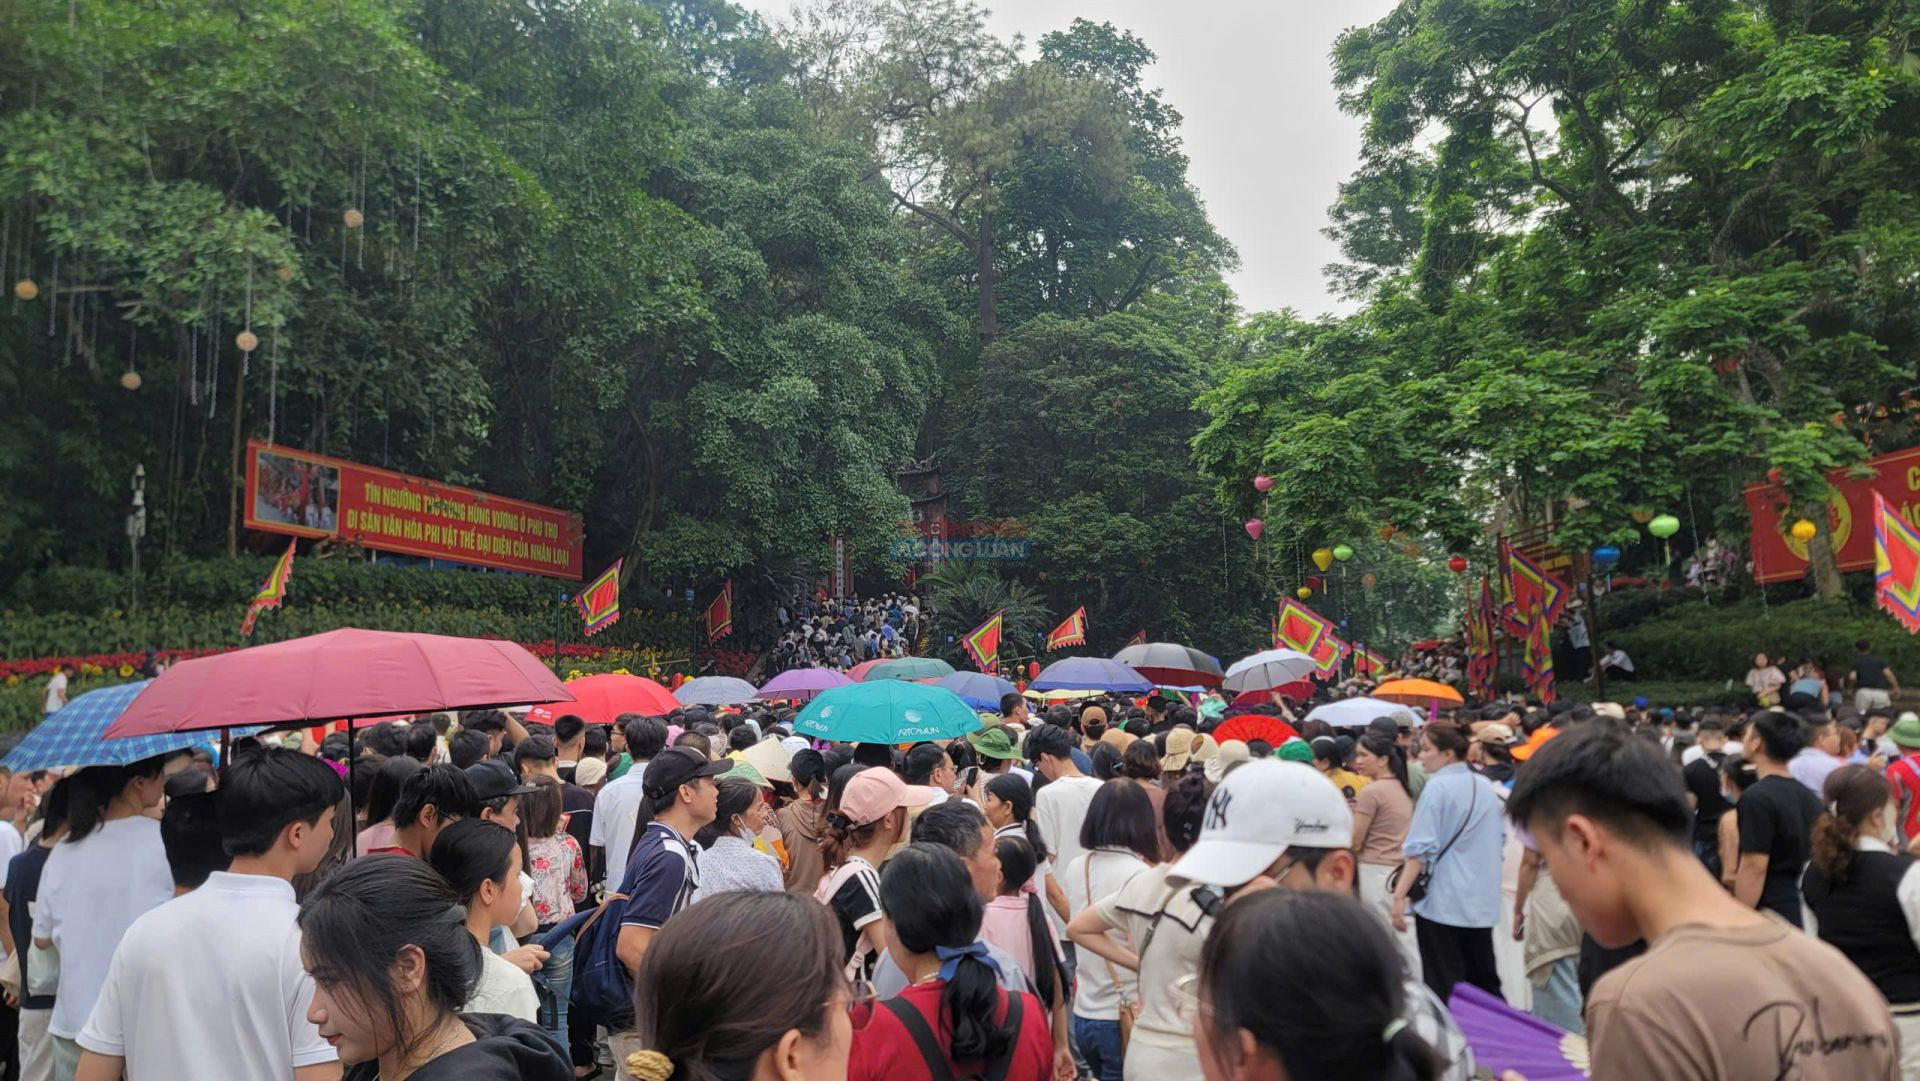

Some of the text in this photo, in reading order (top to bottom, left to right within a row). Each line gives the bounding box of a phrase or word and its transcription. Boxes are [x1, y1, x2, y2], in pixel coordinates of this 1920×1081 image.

[364, 480, 381, 505] TÍN
[467, 503, 490, 526] HÙNG
[492, 510, 519, 532] VƯƠNG
[347, 509, 358, 529] DI
[383, 513, 403, 537] VĂN
[424, 524, 440, 544] PHI
[442, 525, 459, 549] VẬT
[553, 548, 570, 568] LOẠI
